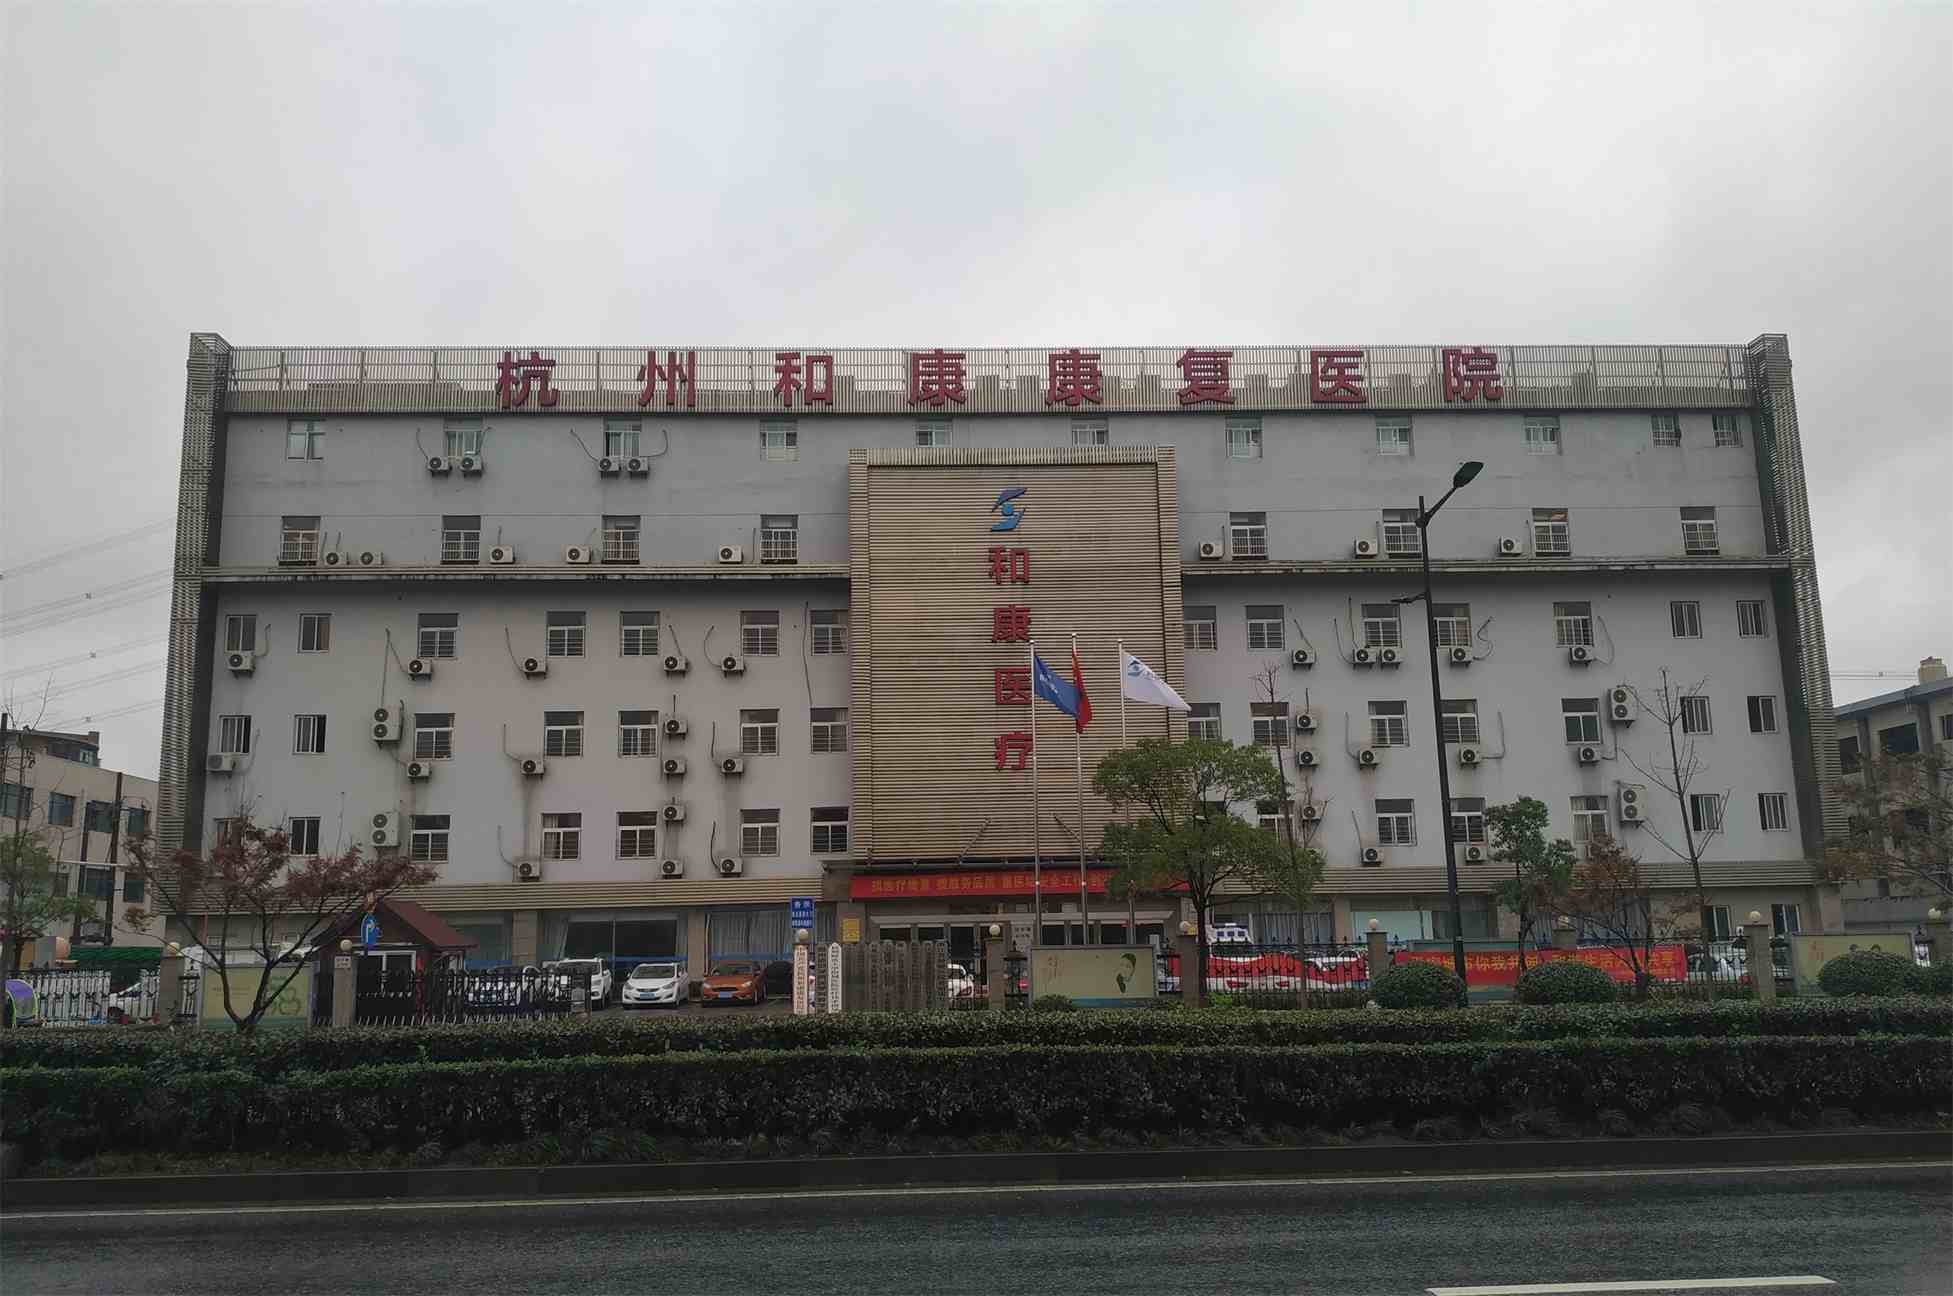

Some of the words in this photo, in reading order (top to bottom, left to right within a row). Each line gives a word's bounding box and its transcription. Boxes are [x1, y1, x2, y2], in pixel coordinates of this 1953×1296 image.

[496, 347, 1504, 408] 杭州和康康复医院
[988, 544, 1034, 771] 和康医疗
